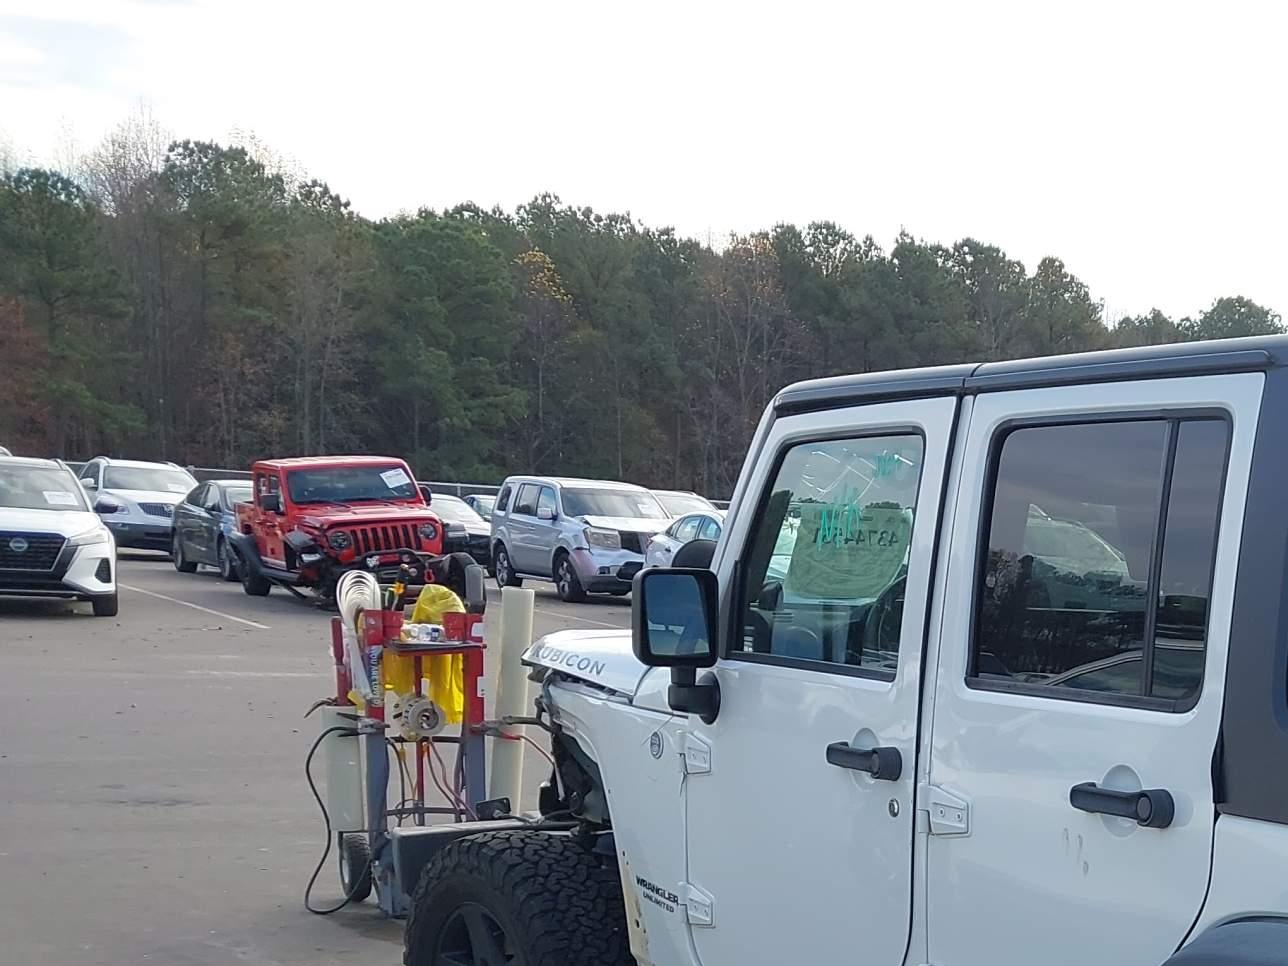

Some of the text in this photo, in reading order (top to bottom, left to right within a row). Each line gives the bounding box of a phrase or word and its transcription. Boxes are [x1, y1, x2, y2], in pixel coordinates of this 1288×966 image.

[532, 645, 606, 676] RUBICON
[635, 874, 679, 905] WRANGLER
[642, 890, 675, 913] UNLIMITED
